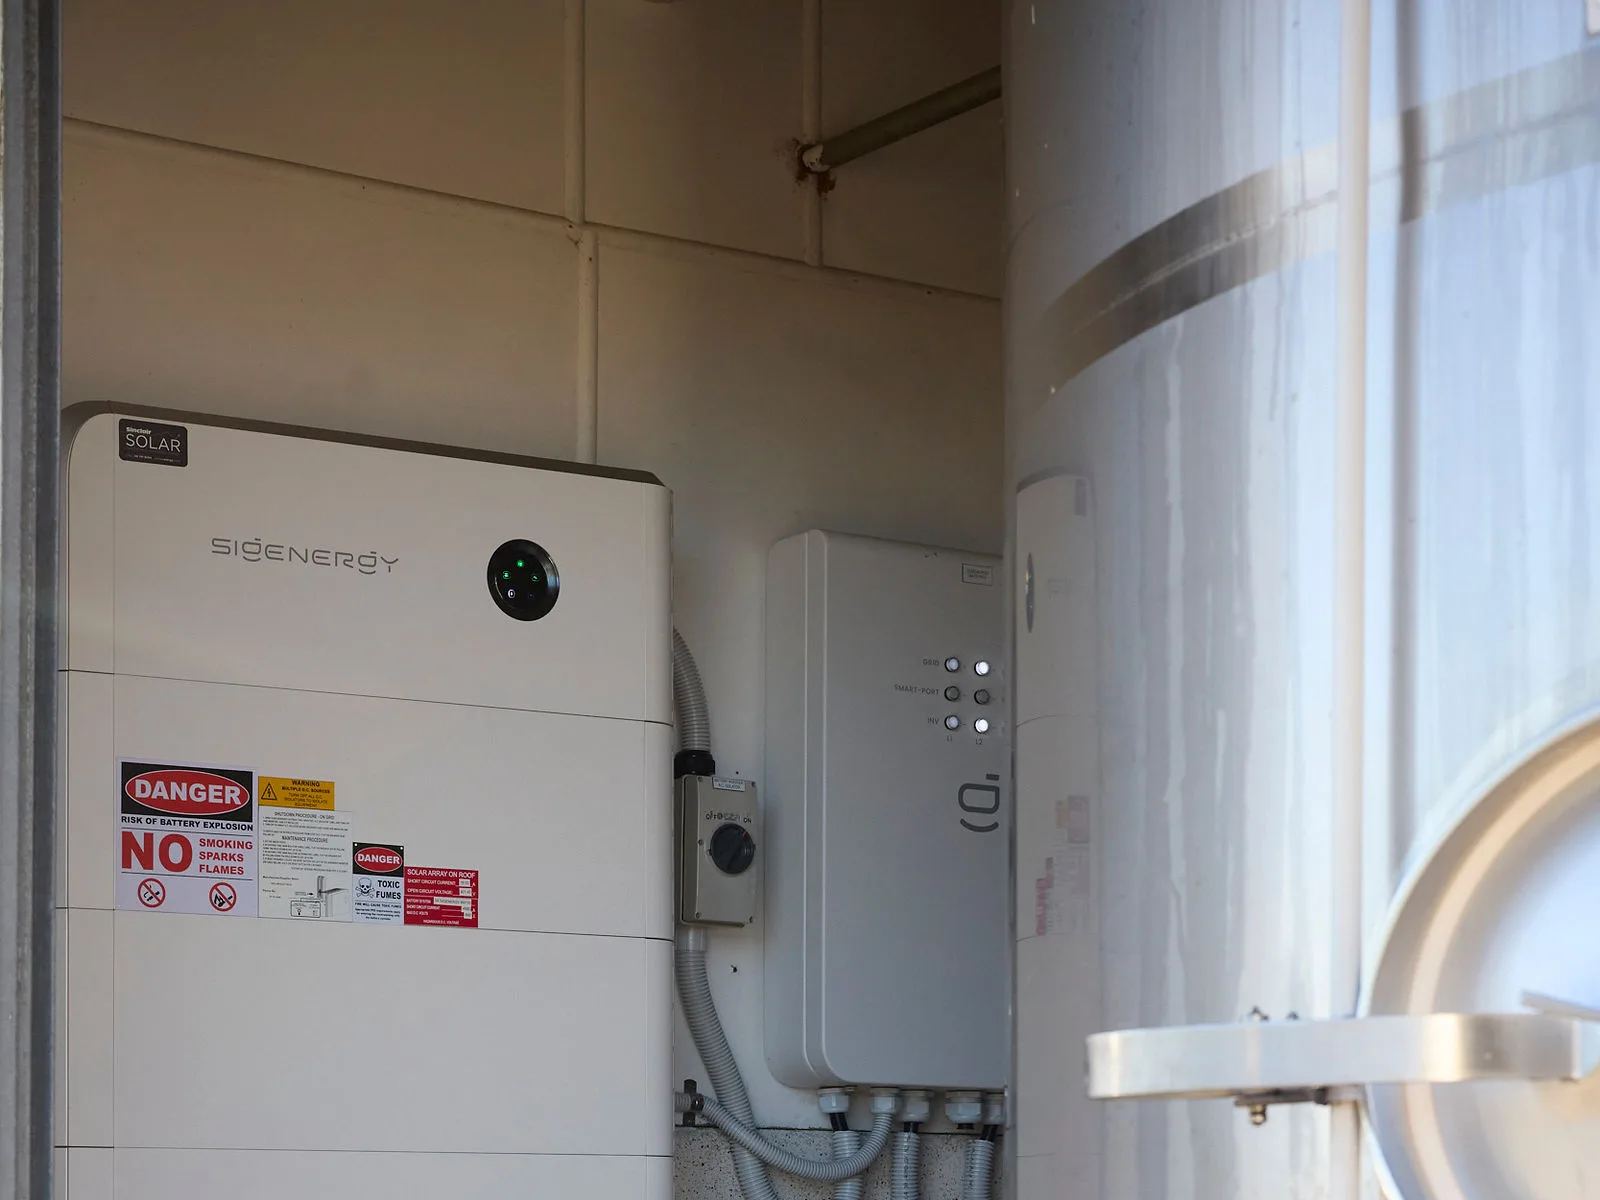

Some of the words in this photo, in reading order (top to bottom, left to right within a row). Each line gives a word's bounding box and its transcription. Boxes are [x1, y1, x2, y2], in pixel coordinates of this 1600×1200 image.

[126, 433, 181, 453] SOLAR
[211, 537, 399, 575] SIGENERGY
[894, 684, 939, 695] SMART-PORT
[927, 717, 940, 725] INV
[292, 779, 320, 787] WARNING
[135, 779, 242, 805] DANGER
[121, 816, 143, 824] RISK
[161, 818, 200, 828] BATTERY
[203, 821, 254, 832] EXPLOSION
[199, 838, 254, 850] SMOKING
[121, 830, 193, 873] NO
[199, 851, 244, 863] SPARKS
[357, 853, 400, 865] DANGER
[199, 864, 244, 875] FLAMES
[407, 869, 428, 877] SOLAR
[377, 880, 400, 889] TOXIC
[376, 891, 402, 900] FUMES
